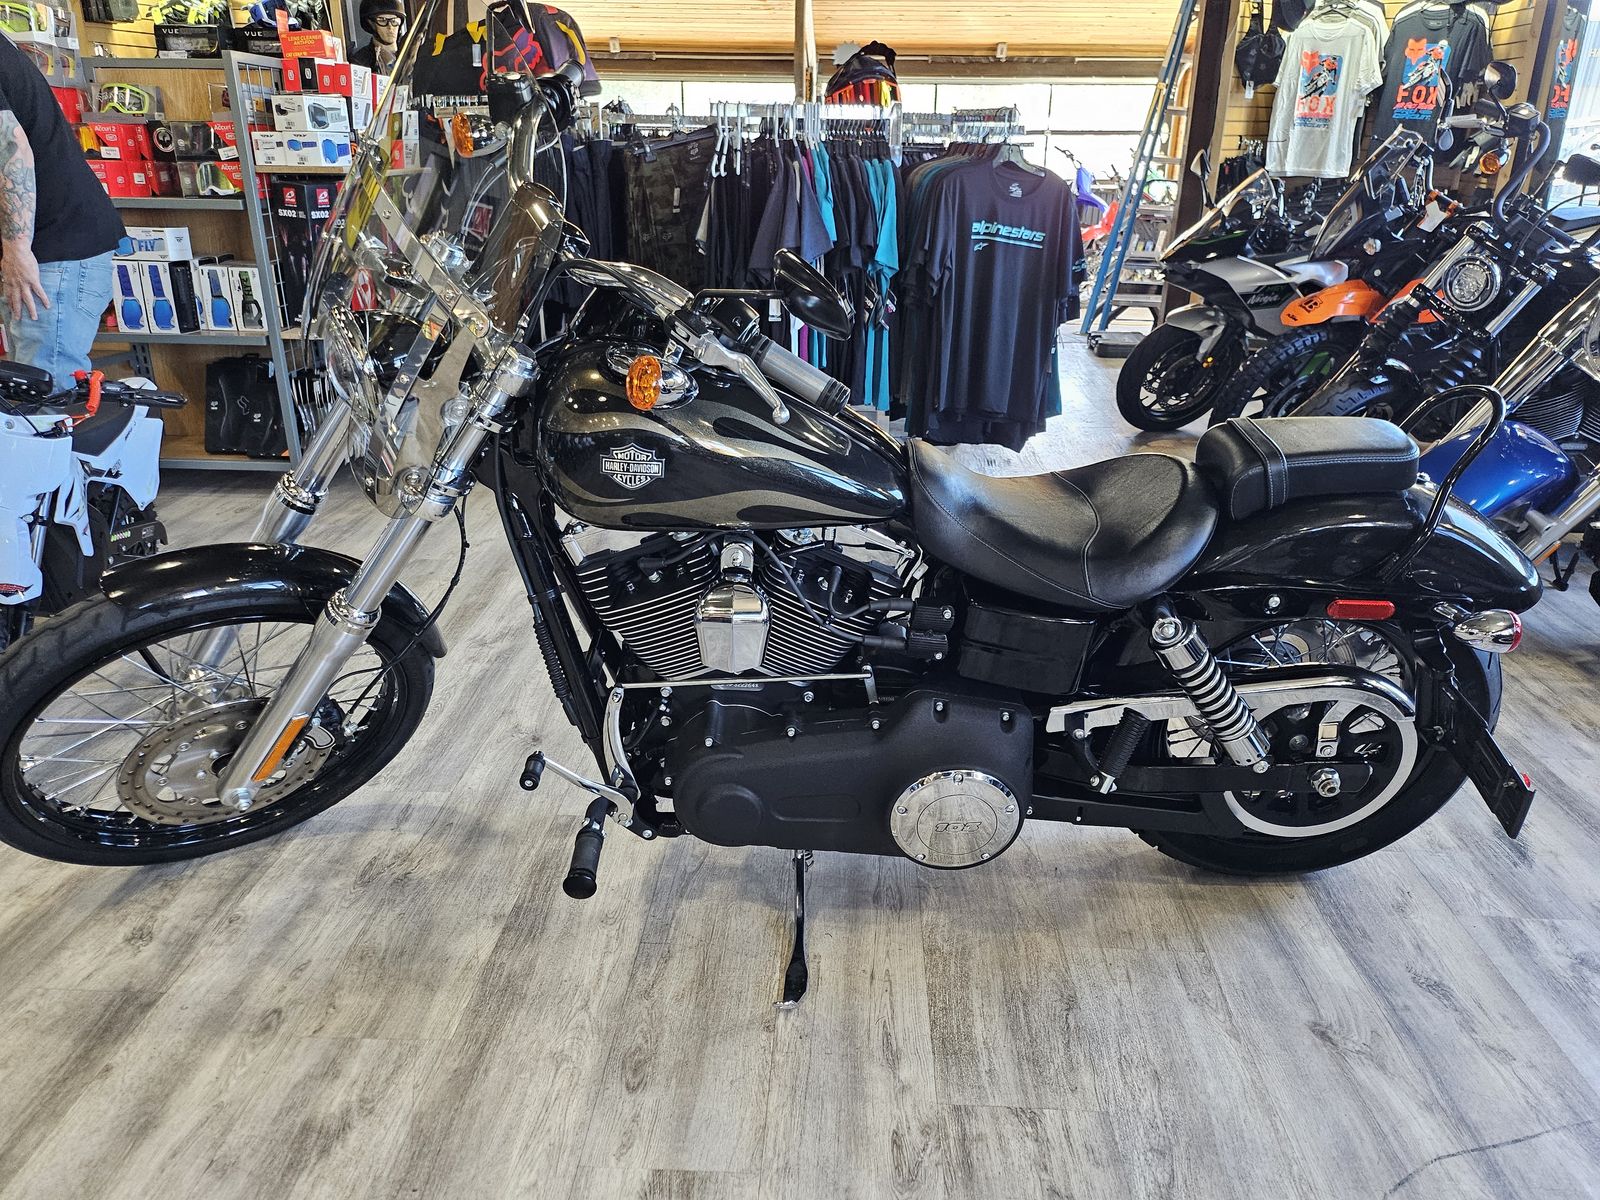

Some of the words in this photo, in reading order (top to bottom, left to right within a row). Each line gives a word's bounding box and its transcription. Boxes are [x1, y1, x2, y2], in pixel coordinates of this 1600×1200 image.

[1397, 84, 1438, 105] FOX
[1297, 95, 1337, 114] FOX
[278, 209, 297, 218] SX02
[311, 211, 329, 219] SX02
[971, 220, 1046, 242] alpinestars
[138, 240, 156, 251] FLY
[617, 450, 648, 462] MOTOR
[605, 461, 659, 474] HARLEY-DAVIDSON
[617, 474, 647, 487] CYCLES
